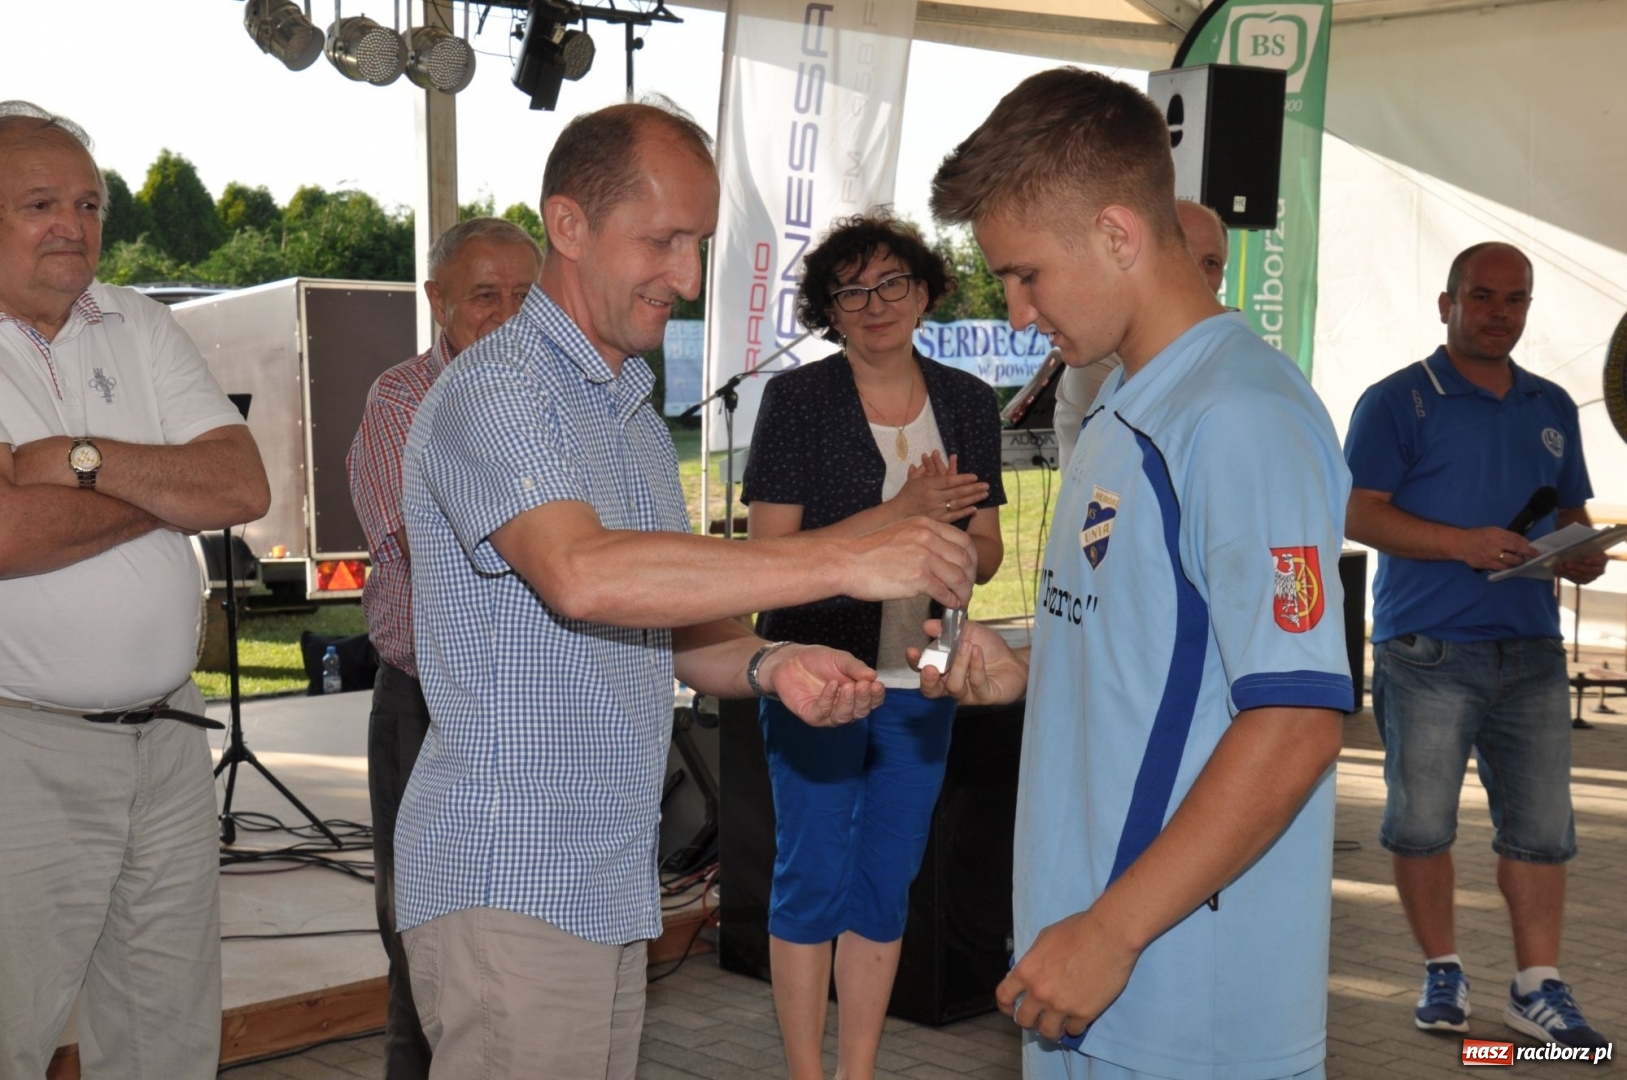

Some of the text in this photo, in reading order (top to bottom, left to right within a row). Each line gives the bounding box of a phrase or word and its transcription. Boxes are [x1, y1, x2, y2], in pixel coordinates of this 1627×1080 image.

[1251, 34, 1286, 57] BS
[841, 151, 862, 203] FM
[744, 242, 770, 378] RADIO
[1084, 522, 1111, 543] UNIA
